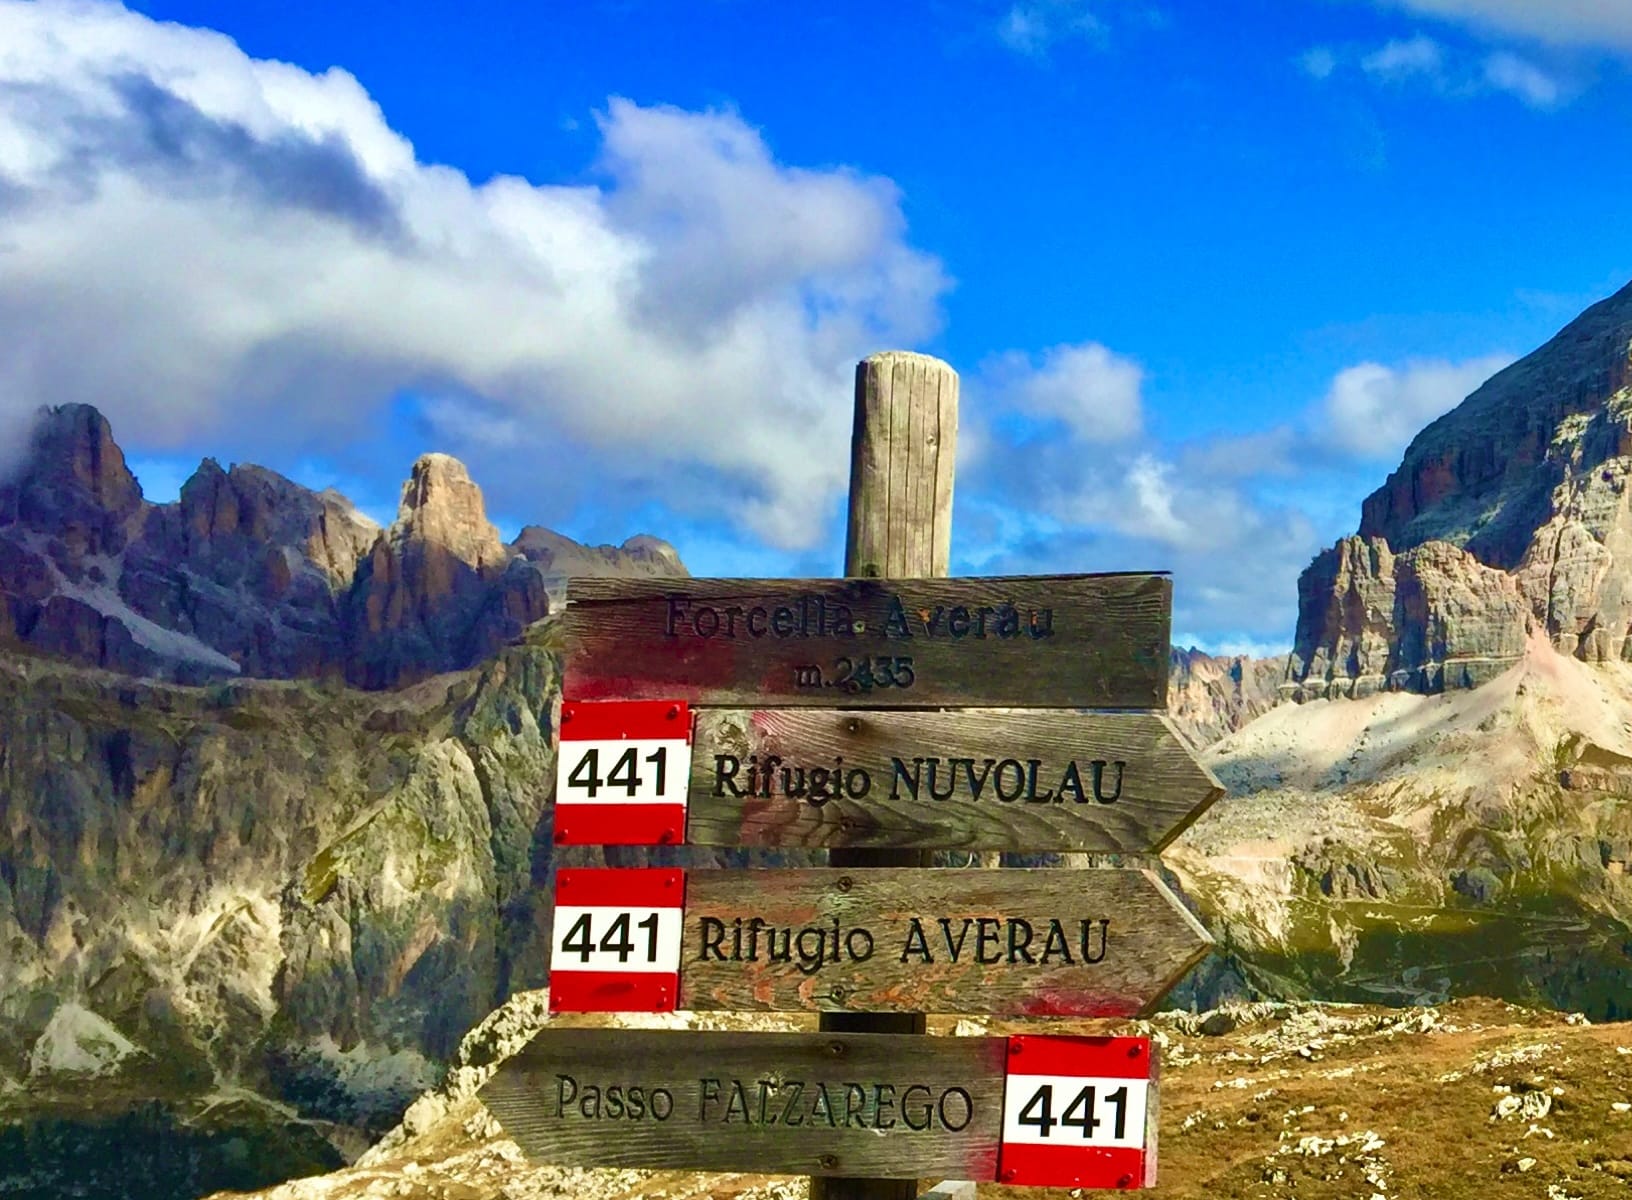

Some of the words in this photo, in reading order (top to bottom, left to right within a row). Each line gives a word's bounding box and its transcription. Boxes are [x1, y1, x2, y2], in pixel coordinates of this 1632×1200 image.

[663, 593, 856, 639] Forcella
[882, 596, 1054, 640] Averau
[567, 746, 666, 798] 441
[712, 754, 871, 807] Rifugio
[888, 756, 1126, 804] NUVOLAU
[561, 912, 659, 962] 441
[699, 916, 874, 975] Rifugio
[899, 917, 1110, 964] AVERAU
[554, 1073, 674, 1122] Passo
[698, 1078, 973, 1132] FALZAREGO
[1017, 1084, 1128, 1139] 441
